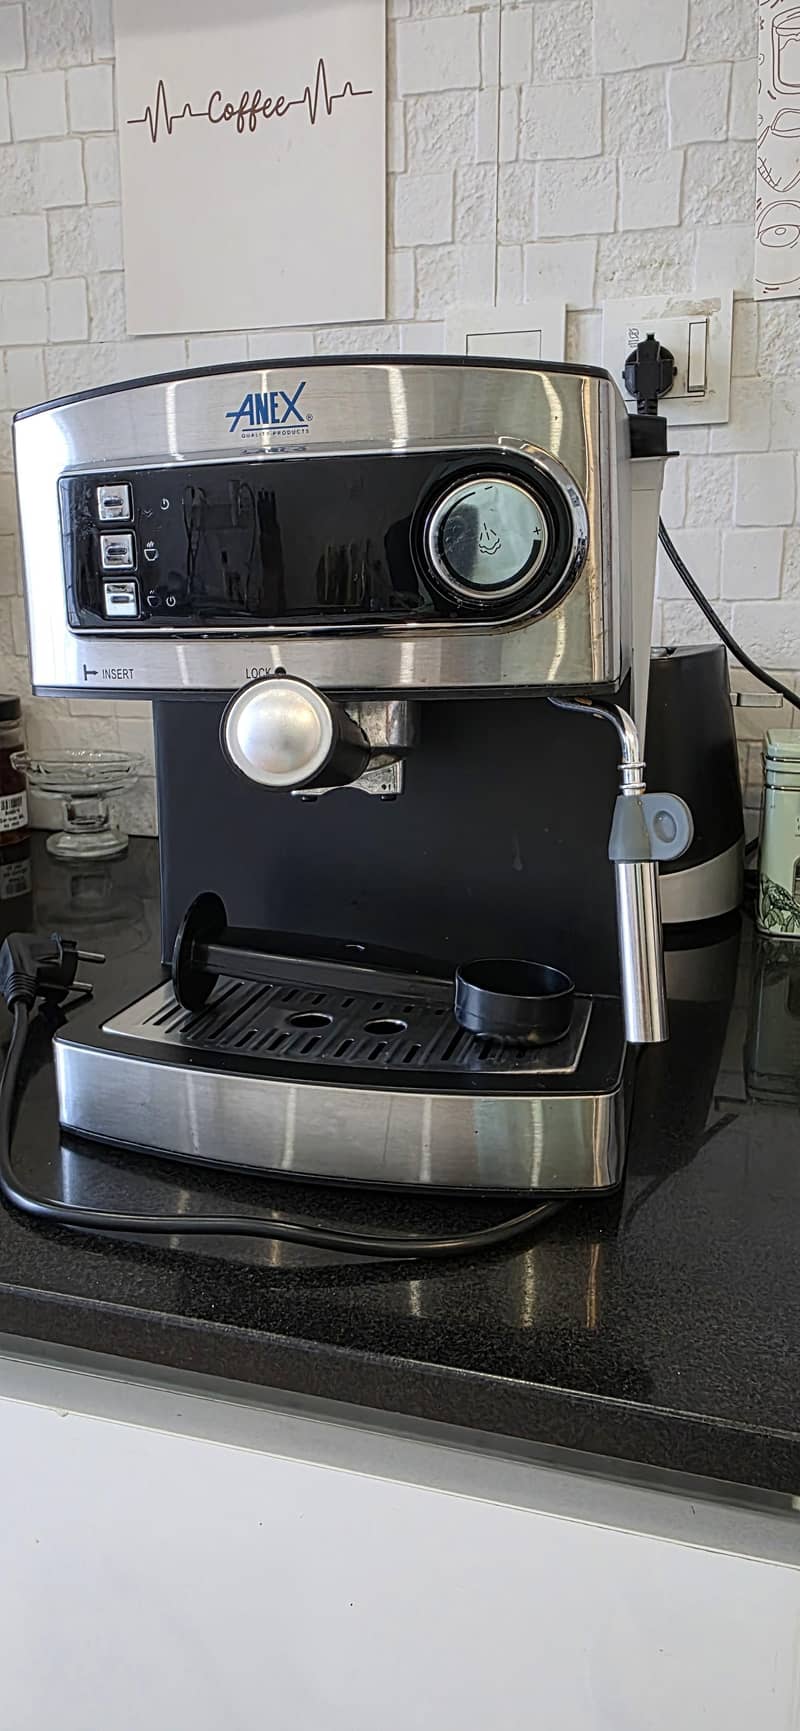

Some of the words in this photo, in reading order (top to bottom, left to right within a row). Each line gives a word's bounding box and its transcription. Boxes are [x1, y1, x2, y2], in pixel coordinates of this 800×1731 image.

[207, 89, 290, 133] Coffee
[272, 428, 310, 436] PRODUCTS
[102, 668, 134, 680] INSERT
[246, 667, 271, 680] LOCK
